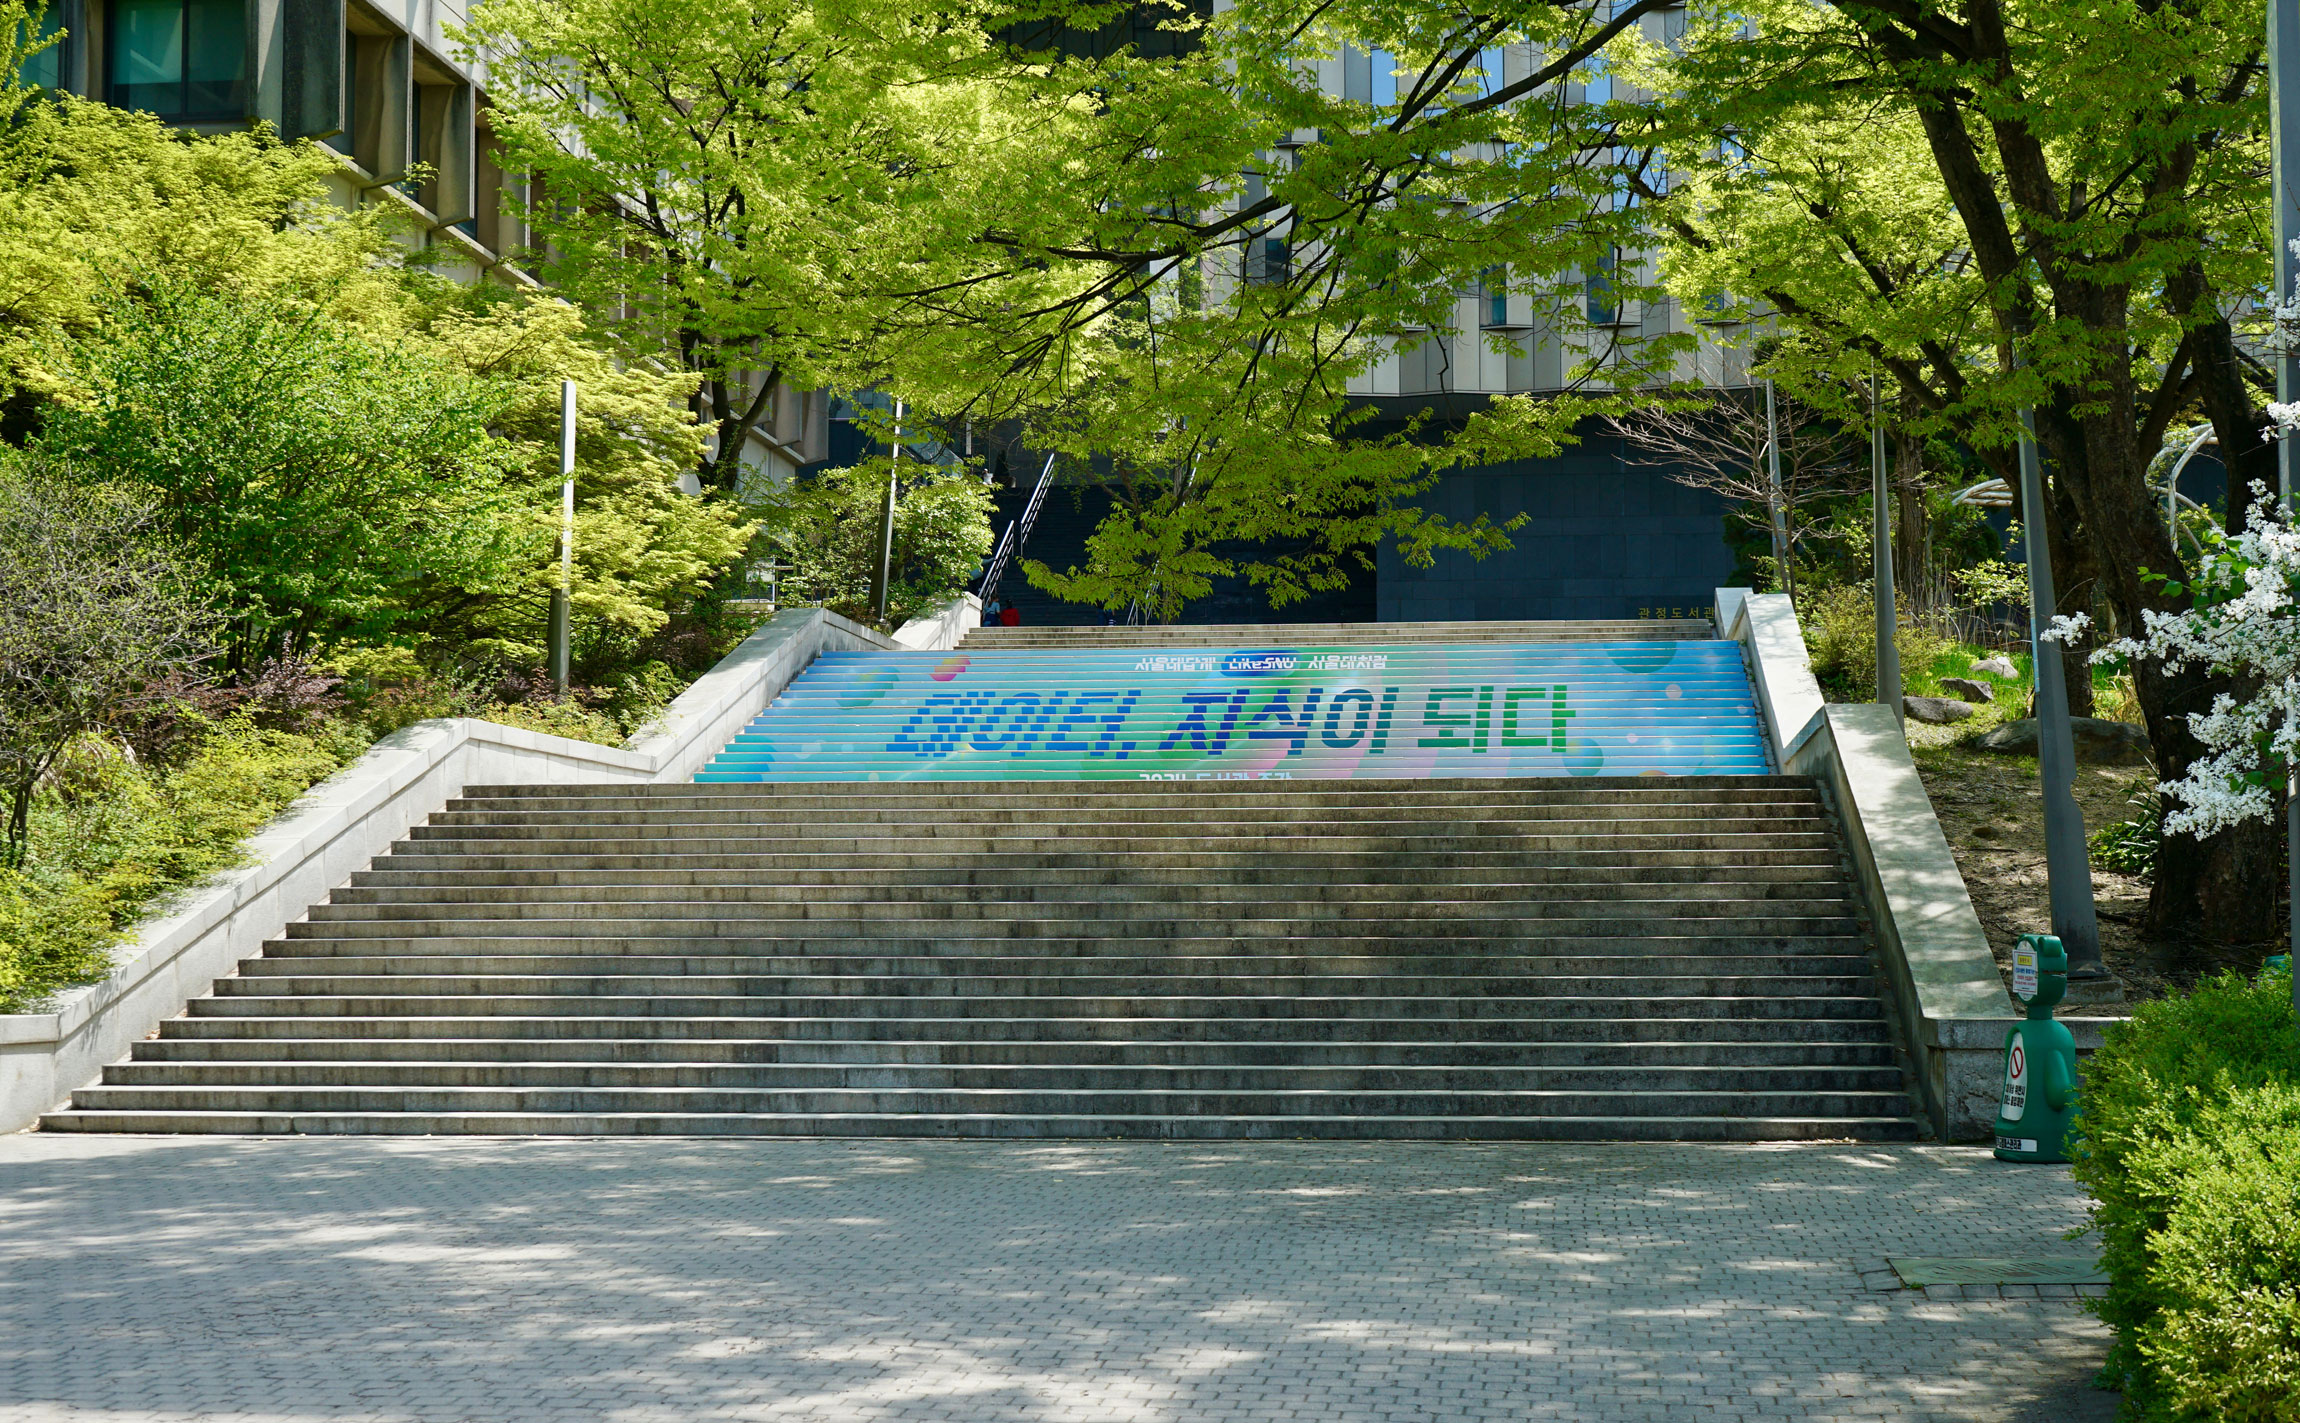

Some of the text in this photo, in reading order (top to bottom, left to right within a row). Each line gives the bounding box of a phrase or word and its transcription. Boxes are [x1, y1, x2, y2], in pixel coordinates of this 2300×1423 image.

[1639, 607, 1714, 619] 관정도서관
[1135, 655, 1388, 671] 서울대답게 LikeSNU 서울대처럼
[1158, 688, 1399, 755] 지식이
[1417, 685, 1576, 753] 되다
